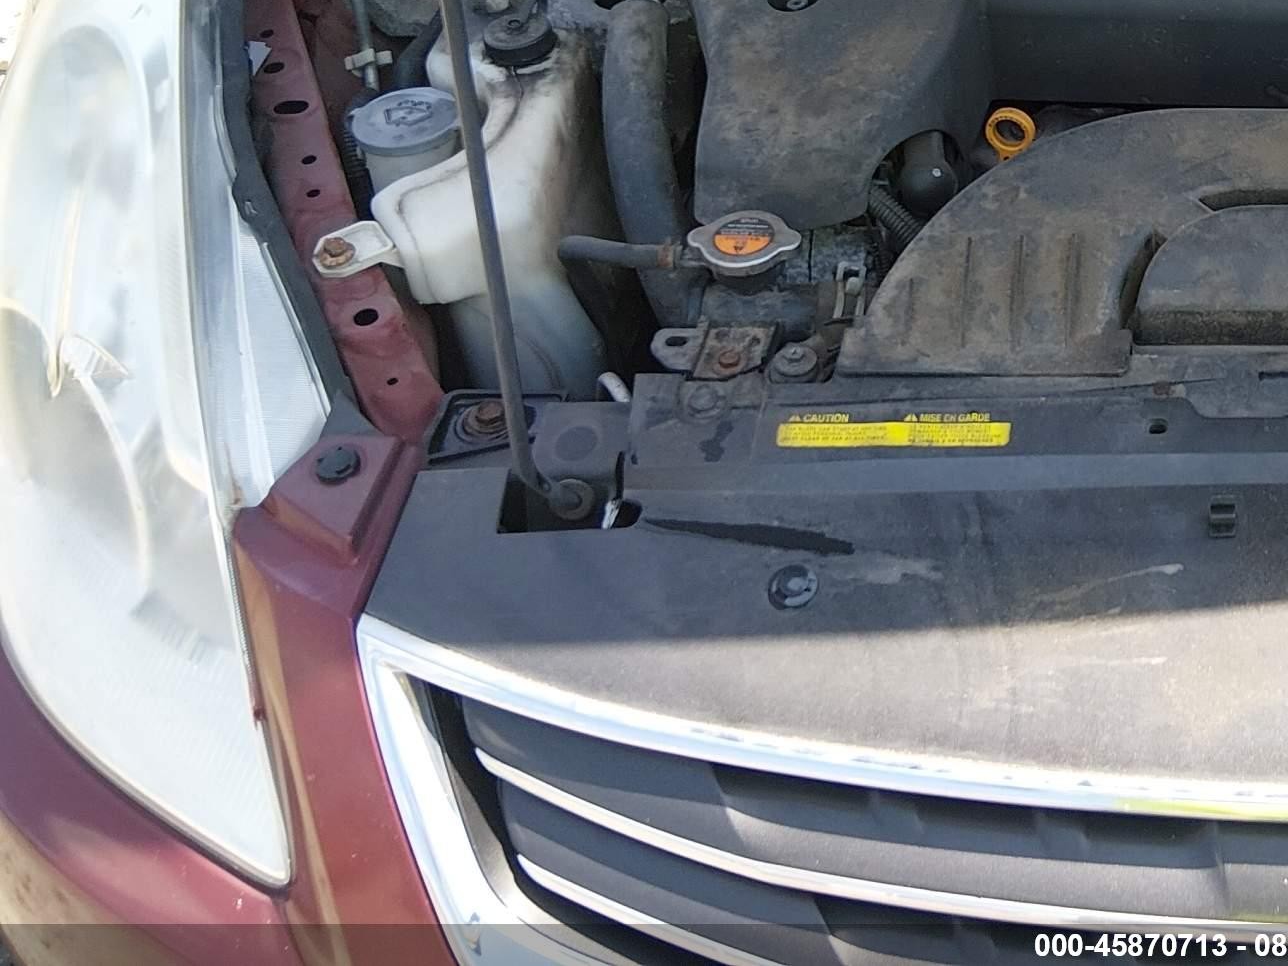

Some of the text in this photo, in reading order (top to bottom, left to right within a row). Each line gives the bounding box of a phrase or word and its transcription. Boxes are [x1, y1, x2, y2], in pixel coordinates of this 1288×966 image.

[803, 413, 849, 423] CAUTION
[920, 413, 941, 422] MISE
[958, 413, 991, 422] GARDE
